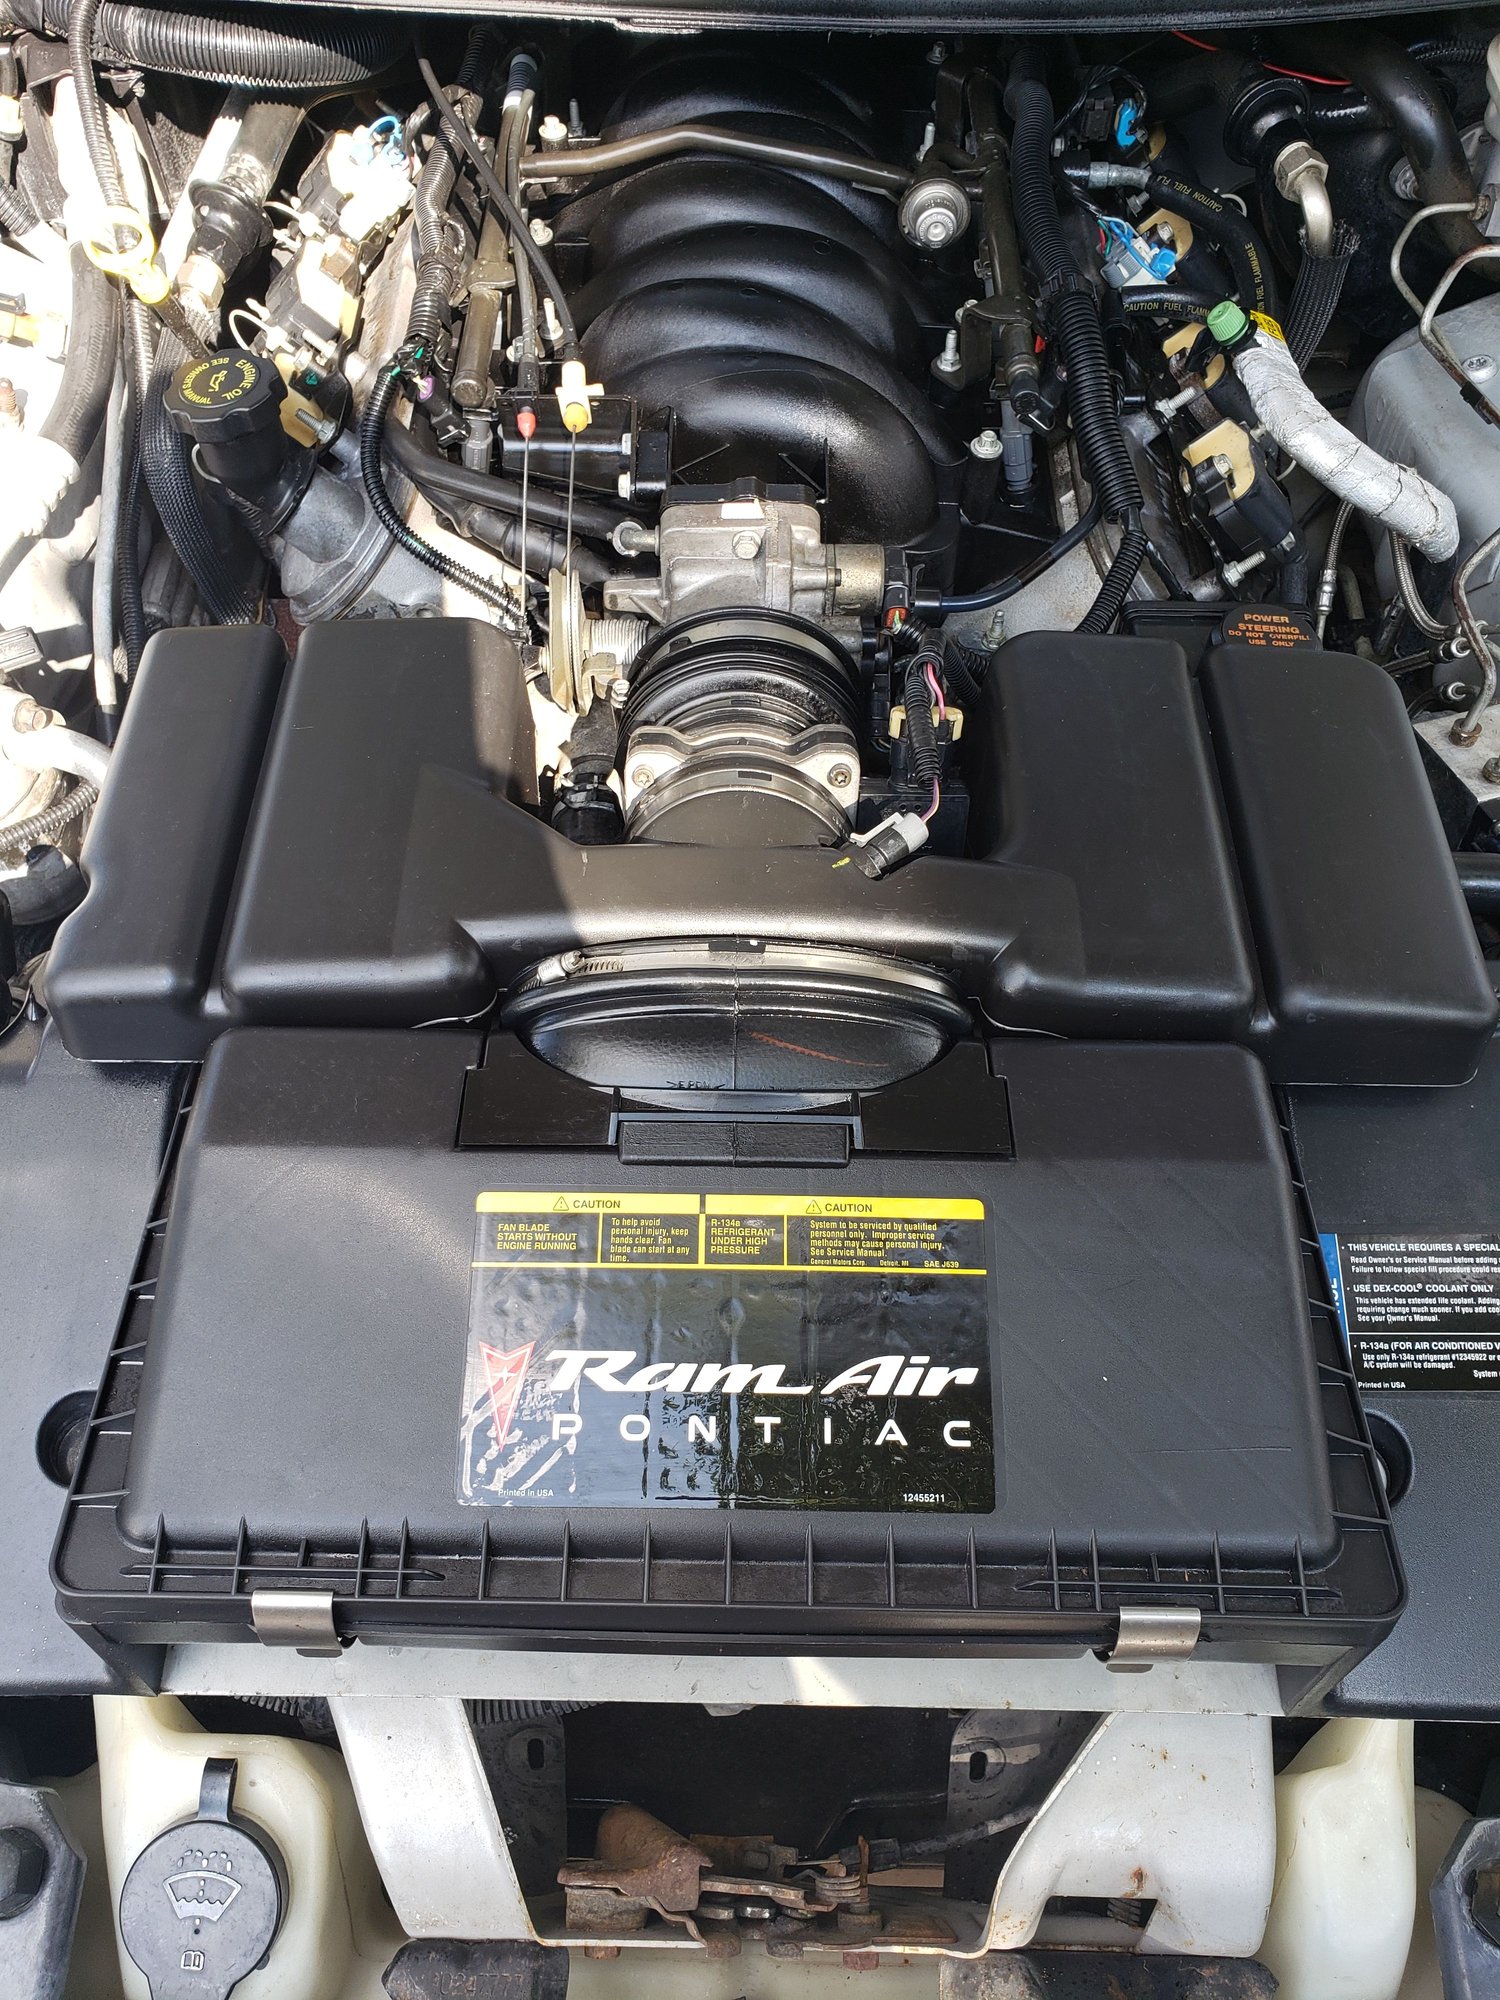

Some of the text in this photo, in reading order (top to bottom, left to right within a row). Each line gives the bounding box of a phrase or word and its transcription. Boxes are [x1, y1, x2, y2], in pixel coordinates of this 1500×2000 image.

[1173, 181, 1192, 195] FUEL
[1192, 192, 1223, 213] CAUTION
[1244, 241, 1263, 285] FLAMMABLE
[1123, 302, 1159, 312] CAUTION
[1163, 302, 1183, 312] FUEL
[210, 357, 230, 367] SEE
[222, 359, 257, 401] ENGINE OIL
[182, 388, 213, 405] MANUAL
[1244, 613, 1290, 624] POWER
[1238, 623, 1300, 634] STEERING
[572, 1200, 622, 1209] CAUTION
[824, 1203, 873, 1213] CAUTION
[612, 1218, 660, 1228] To help avoid
[710, 1218, 741, 1227] R-134a
[810, 1220, 938, 1232] System to be serviced by qualified
[498, 1224, 550, 1232] FAN BLADE
[610, 1227, 689, 1237] personal injury, keep
[710, 1228, 776, 1236] REFRIGERANT
[497, 1232, 578, 1242] STARTS WITHOUT
[610, 1236, 672, 1244] hands clear. Fan
[810, 1229, 936, 1241] personnel only. Improper service
[496, 1242, 577, 1250] ENGINE RUNNING
[710, 1236, 768, 1246] UNDER HIGH
[810, 1238, 945, 1251] methods may cause personal injury.
[610, 1245, 632, 1253] blade
[648, 1246, 666, 1254] start
[667, 1246, 676, 1254] at
[676, 1247, 690, 1256] any
[710, 1246, 760, 1254] PRESSURE
[1347, 1243, 1368, 1251] THIS
[1369, 1243, 1406, 1252] VEHICLE
[1408, 1244, 1454, 1252] REQUIRES
[1454, 1244, 1462, 1252] A
[610, 1254, 630, 1262] time.
[810, 1248, 888, 1258] See Service Manual.
[810, 1258, 832, 1266] General
[924, 1260, 940, 1268] SAE
[1350, 1256, 1367, 1264] Read
[1368, 1256, 1394, 1264] Owner's
[1403, 1256, 1427, 1264] Service
[1428, 1256, 1452, 1264] Manual
[1453, 1256, 1474, 1264] before
[1476, 1256, 1498, 1265] adding
[1404, 1266, 1427, 1274] special
[1438, 1266, 1470, 1274] procedure
[1472, 1266, 1490, 1274] could
[1353, 1284, 1372, 1292] USE
[1426, 1284, 1472, 1292] COOLANT
[1472, 1284, 1494, 1292] ONLY
[1355, 1296, 1369, 1304] This
[1370, 1296, 1393, 1304] vehicle
[1356, 1306, 1386, 1314] requiring
[1386, 1306, 1410, 1314] change
[1462, 1307, 1474, 1315] you
[1474, 1306, 1487, 1314] add
[1358, 1314, 1370, 1322] See
[1386, 1314, 1412, 1322] Owner's
[1414, 1314, 1440, 1322] Manual.
[1360, 1342, 1389, 1350] R-134a
[1390, 1341, 1412, 1352] (FOR
[1414, 1342, 1430, 1350] AIR
[1432, 1342, 1493, 1350] CONDITIONED
[1376, 1353, 1390, 1362] only
[1416, 1354, 1450, 1362] refrigerant
[1376, 1362, 1398, 1370] system
[1423, 1362, 1456, 1370] damaged.
[545, 1350, 980, 1397] Ram Air
[1473, 1370, 1498, 1378] System
[552, 1414, 972, 1447] PONTIAC
[498, 1489, 526, 1497] Printed
[536, 1489, 554, 1497] USA
[902, 1494, 946, 1503] 12455211
